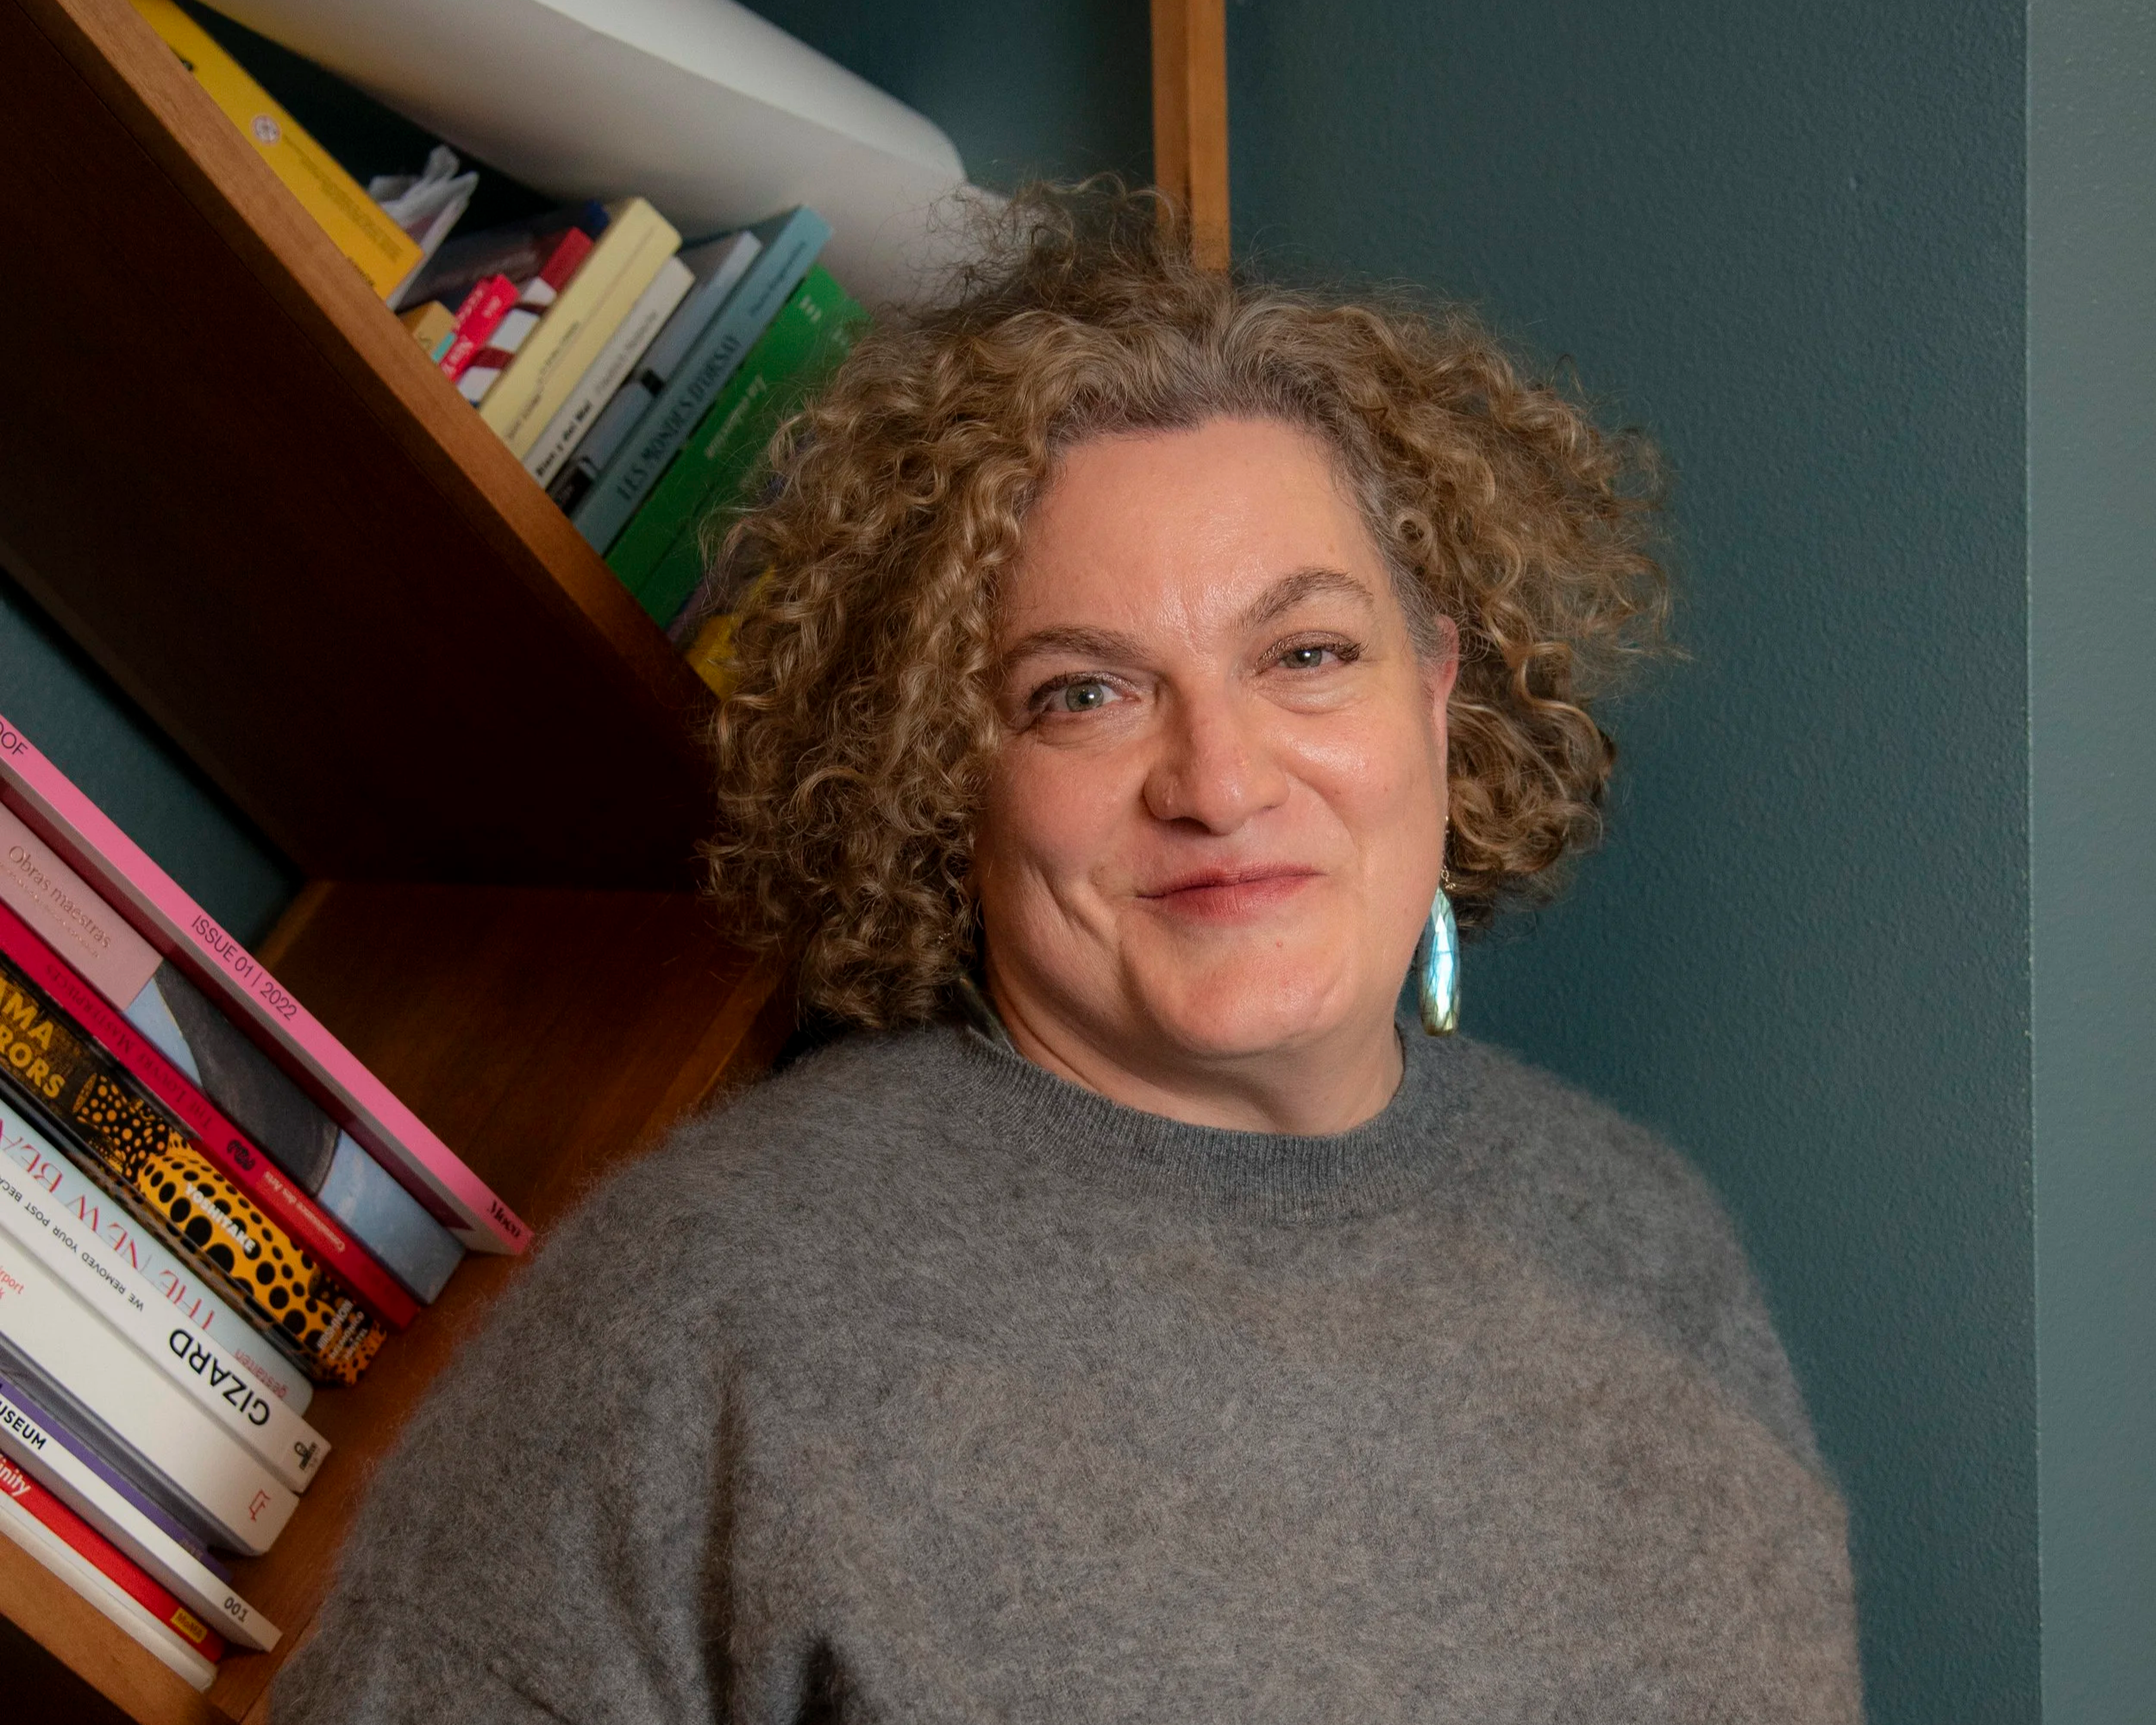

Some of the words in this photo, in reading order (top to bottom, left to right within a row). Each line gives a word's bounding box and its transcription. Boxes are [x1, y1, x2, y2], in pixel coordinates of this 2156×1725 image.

[7, 844, 53, 891] Obras
[48, 886, 114, 949] maestras
[191, 915, 239, 963] ISSUE
[230, 955, 256, 980] 01
[260, 982, 298, 1020] 2022
[23, 1201, 51, 1226] POST
[65, 1193, 154, 1274] NEW
[184, 1182, 256, 1252] YOSHITAKE
[50, 1225, 80, 1252] YOUR
[79, 1251, 127, 1294] REMOVED
[127, 1292, 145, 1310] WE
[168, 1327, 270, 1426] GIZARD
[0, 1453, 31, 1496] inity
[222, 1595, 250, 1622] 001
